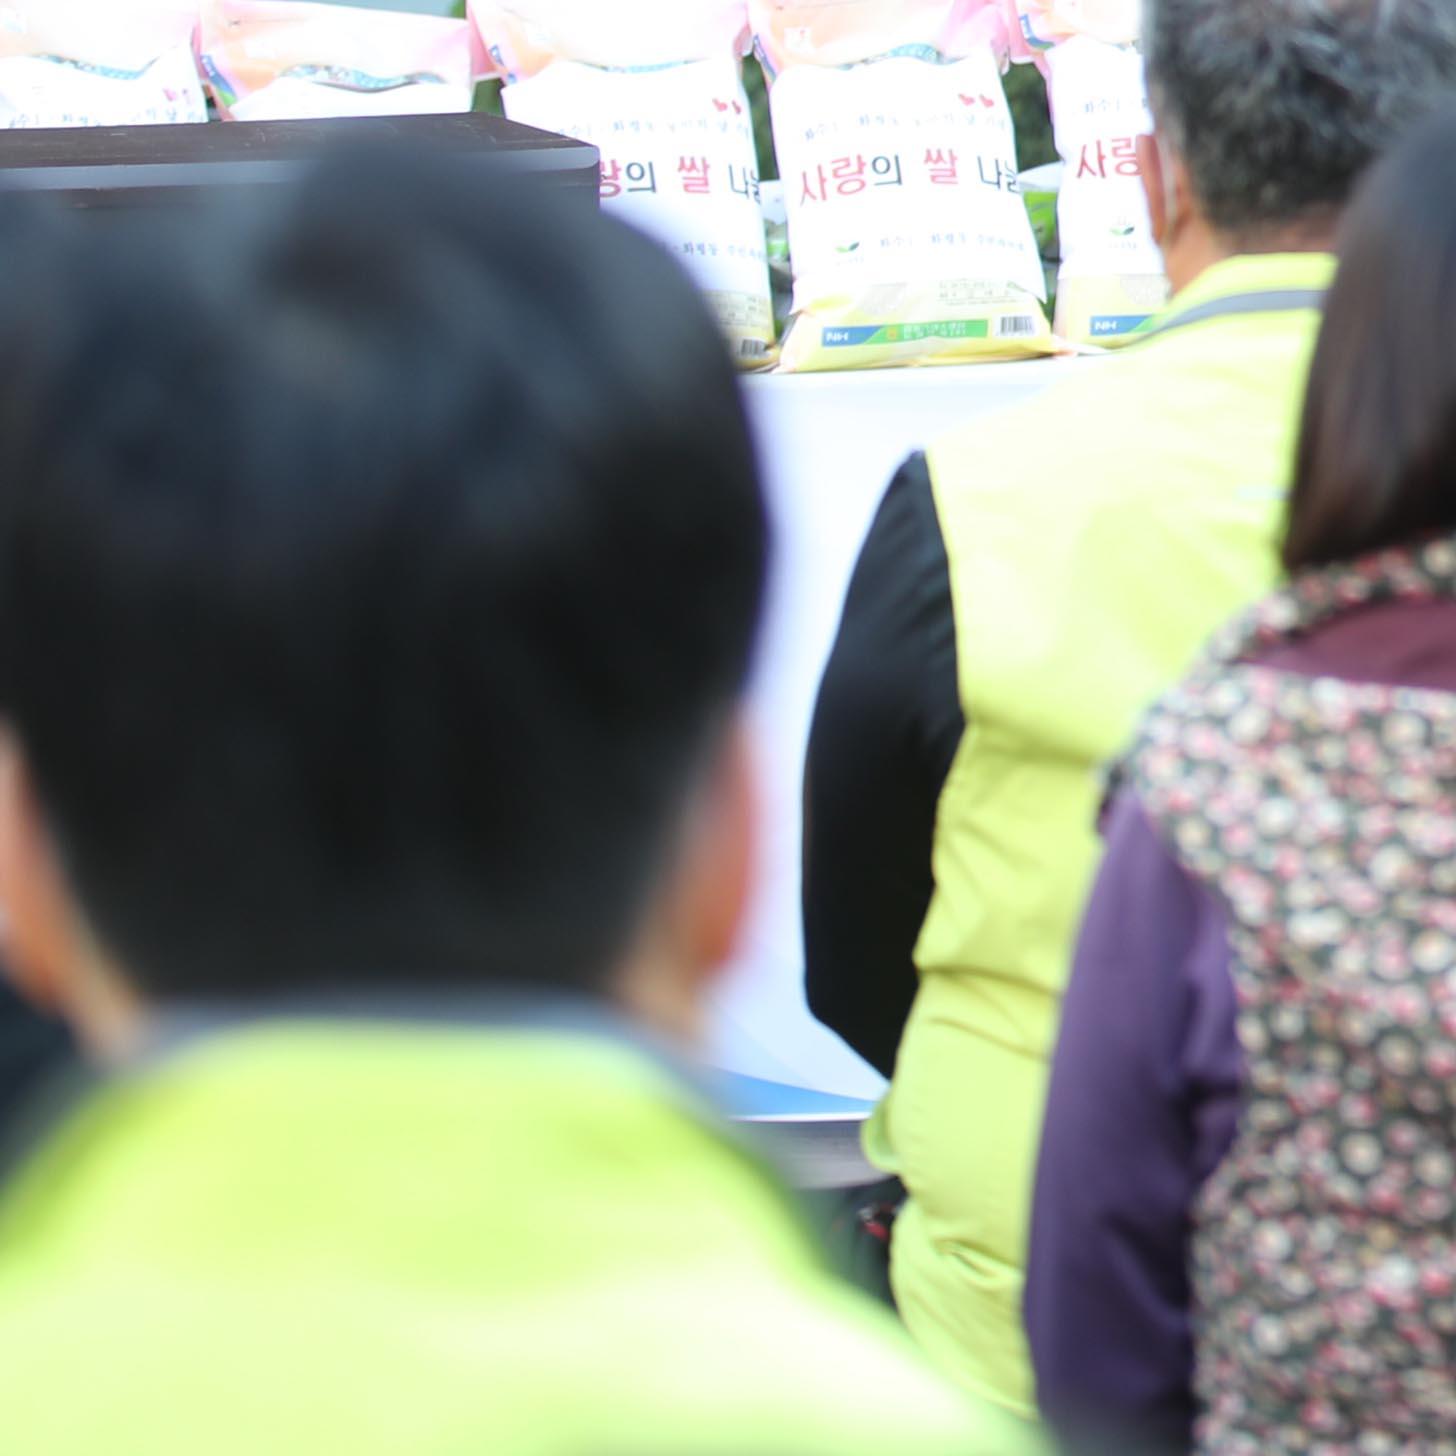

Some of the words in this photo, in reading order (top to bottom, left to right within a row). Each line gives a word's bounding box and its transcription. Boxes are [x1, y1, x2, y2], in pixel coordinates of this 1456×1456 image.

[677, 155, 711, 194] 쌀
[800, 153, 903, 207] 사랑의
[923, 148, 959, 185] 쌀
[1093, 319, 1118, 331] NH
